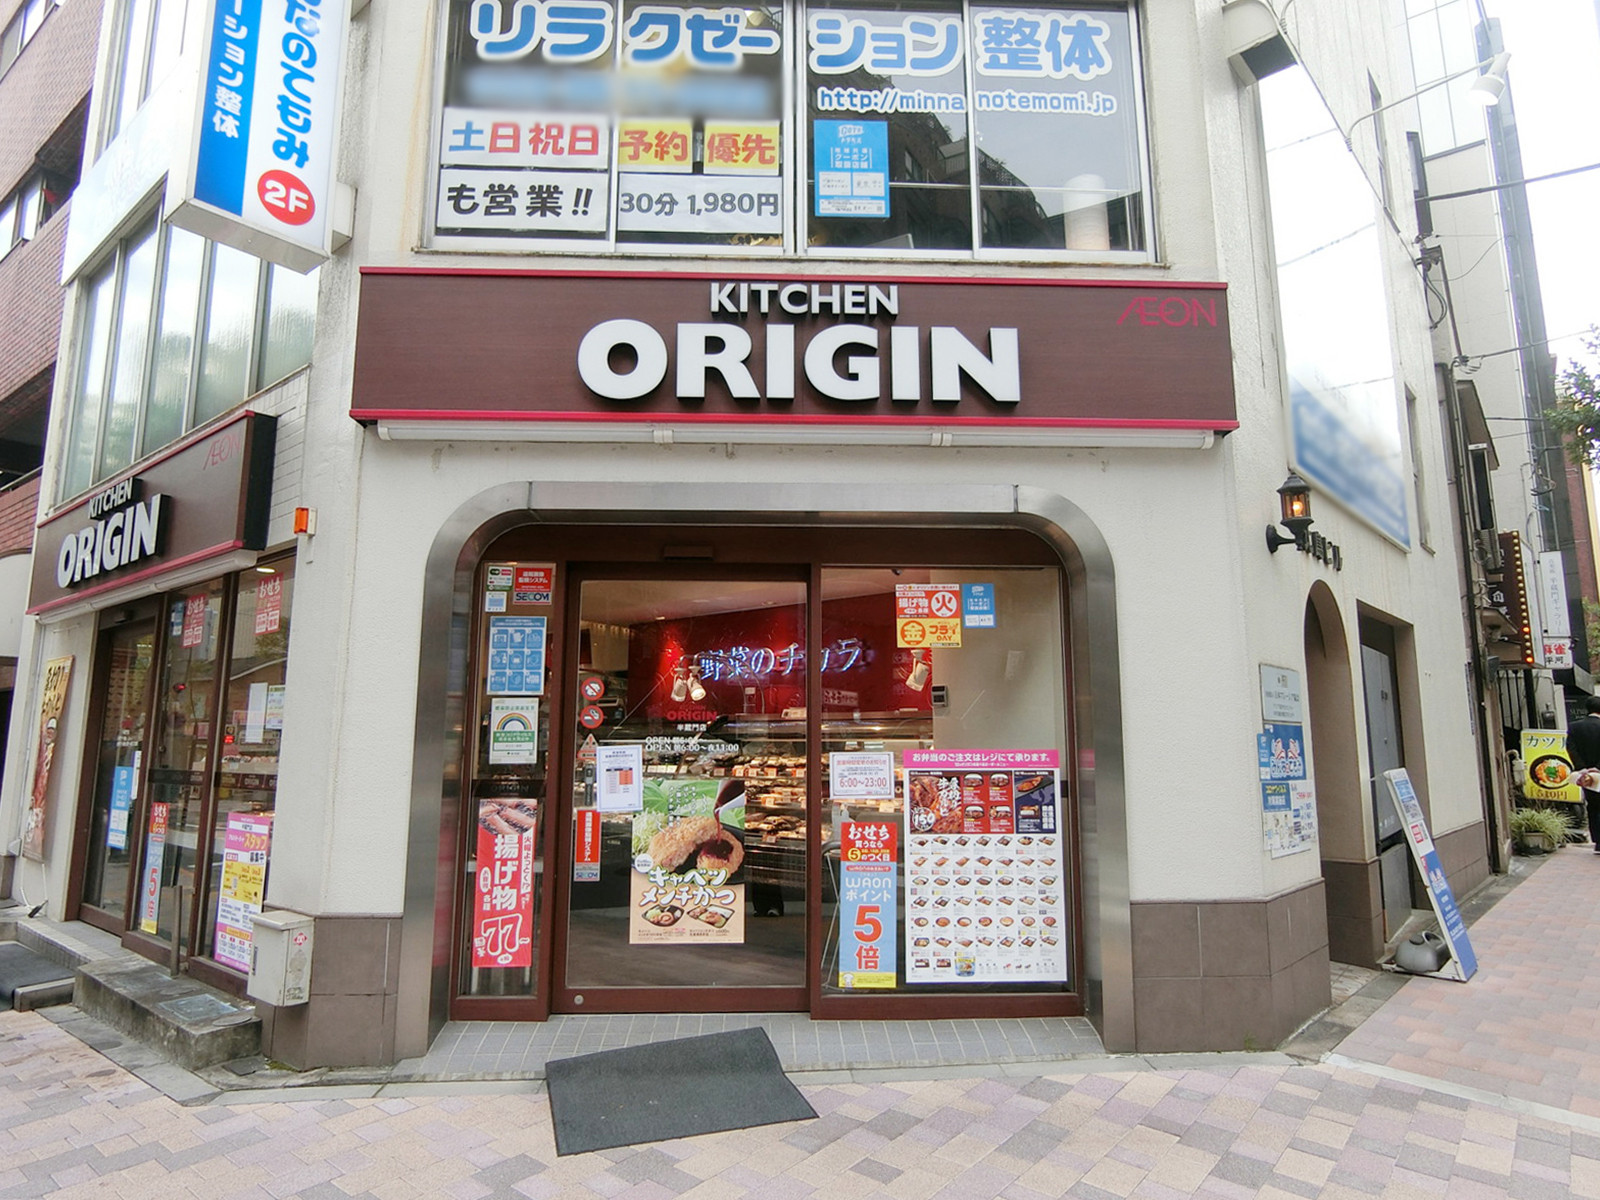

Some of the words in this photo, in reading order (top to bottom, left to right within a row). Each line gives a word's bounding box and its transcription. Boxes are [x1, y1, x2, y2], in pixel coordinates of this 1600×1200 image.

[448, 121, 600, 157] 土日祝日
[618, 130, 689, 162] 予約
[706, 132, 777, 165] 優先
[264, 179, 309, 213] 2F
[620, 193, 679, 217] 30分
[687, 193, 779, 217] 1,980円
[710, 282, 900, 320] KITCHEN
[577, 318, 1022, 407] ORIGIN
[88, 476, 135, 519] KITCHEN
[57, 493, 162, 589] ORIGIN
[515, 592, 550, 602] SECOM
[934, 594, 954, 614] 火
[666, 711, 718, 721] ORIGIN
[847, 823, 890, 840] おせち
[492, 833, 519, 912] 揚げ物
[648, 865, 729, 888] キャベツ
[639, 885, 737, 908] メンチかつ
[845, 889, 892, 902] ポイント
[854, 904, 883, 943] 5
[855, 945, 880, 970] 倍
